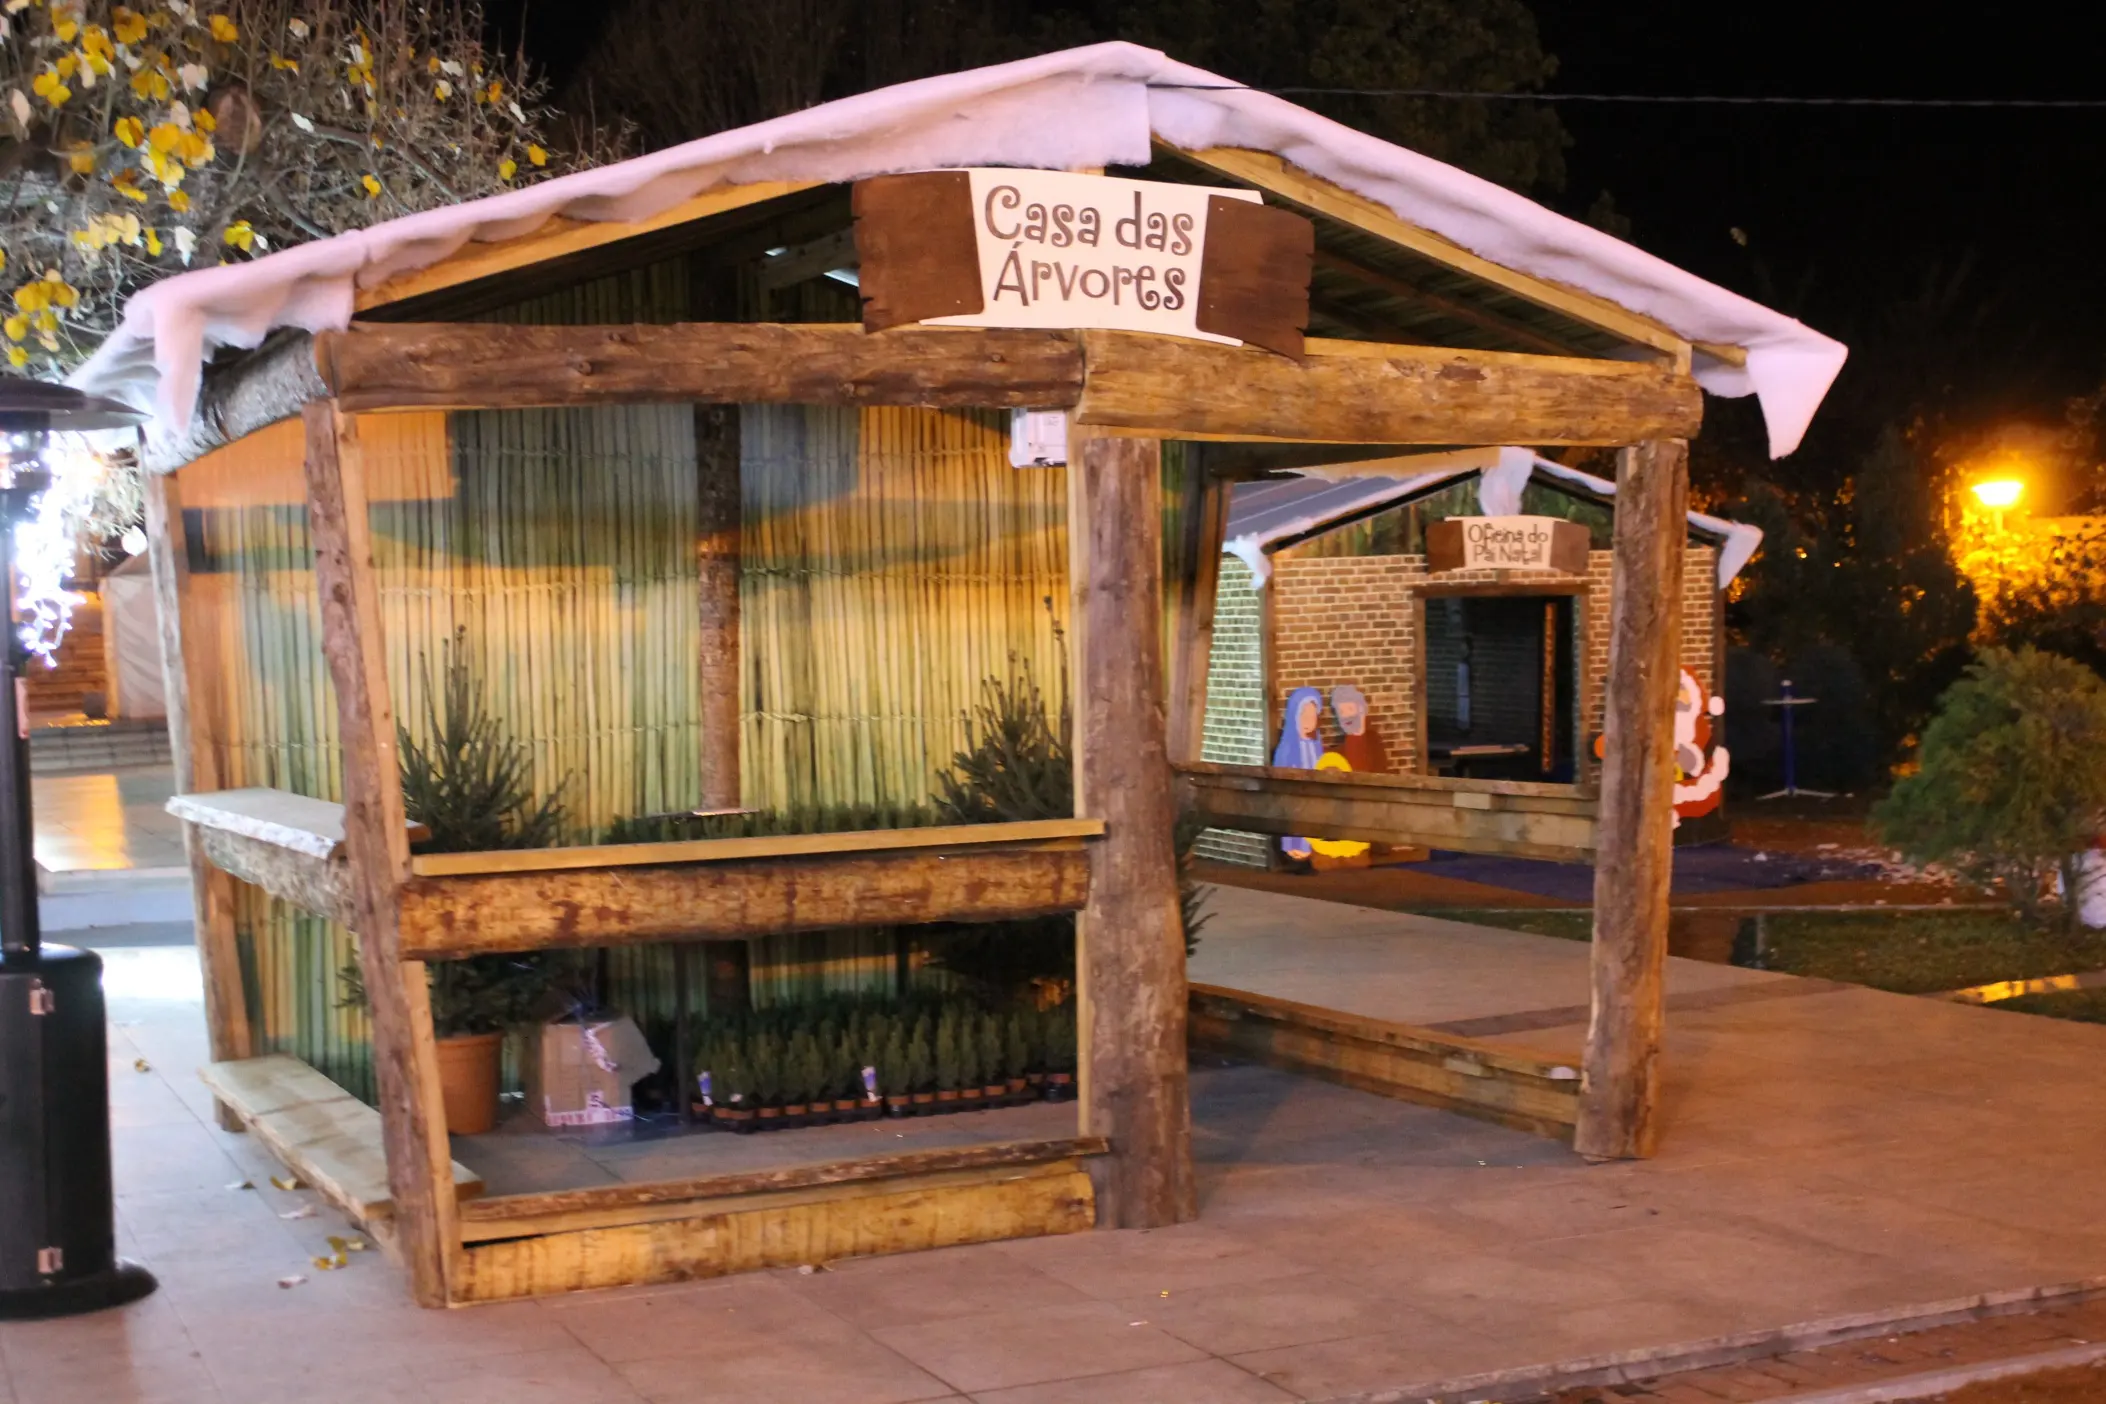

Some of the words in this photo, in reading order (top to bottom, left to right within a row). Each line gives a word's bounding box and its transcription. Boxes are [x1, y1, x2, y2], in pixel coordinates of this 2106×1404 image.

[984, 185, 1101, 248] Casa
[1115, 191, 1194, 256] das
[993, 242, 1187, 311] Árvores
[1468, 523, 1524, 546] Oficina
[1528, 524, 1548, 543] do
[1500, 543, 1542, 564] Natal
